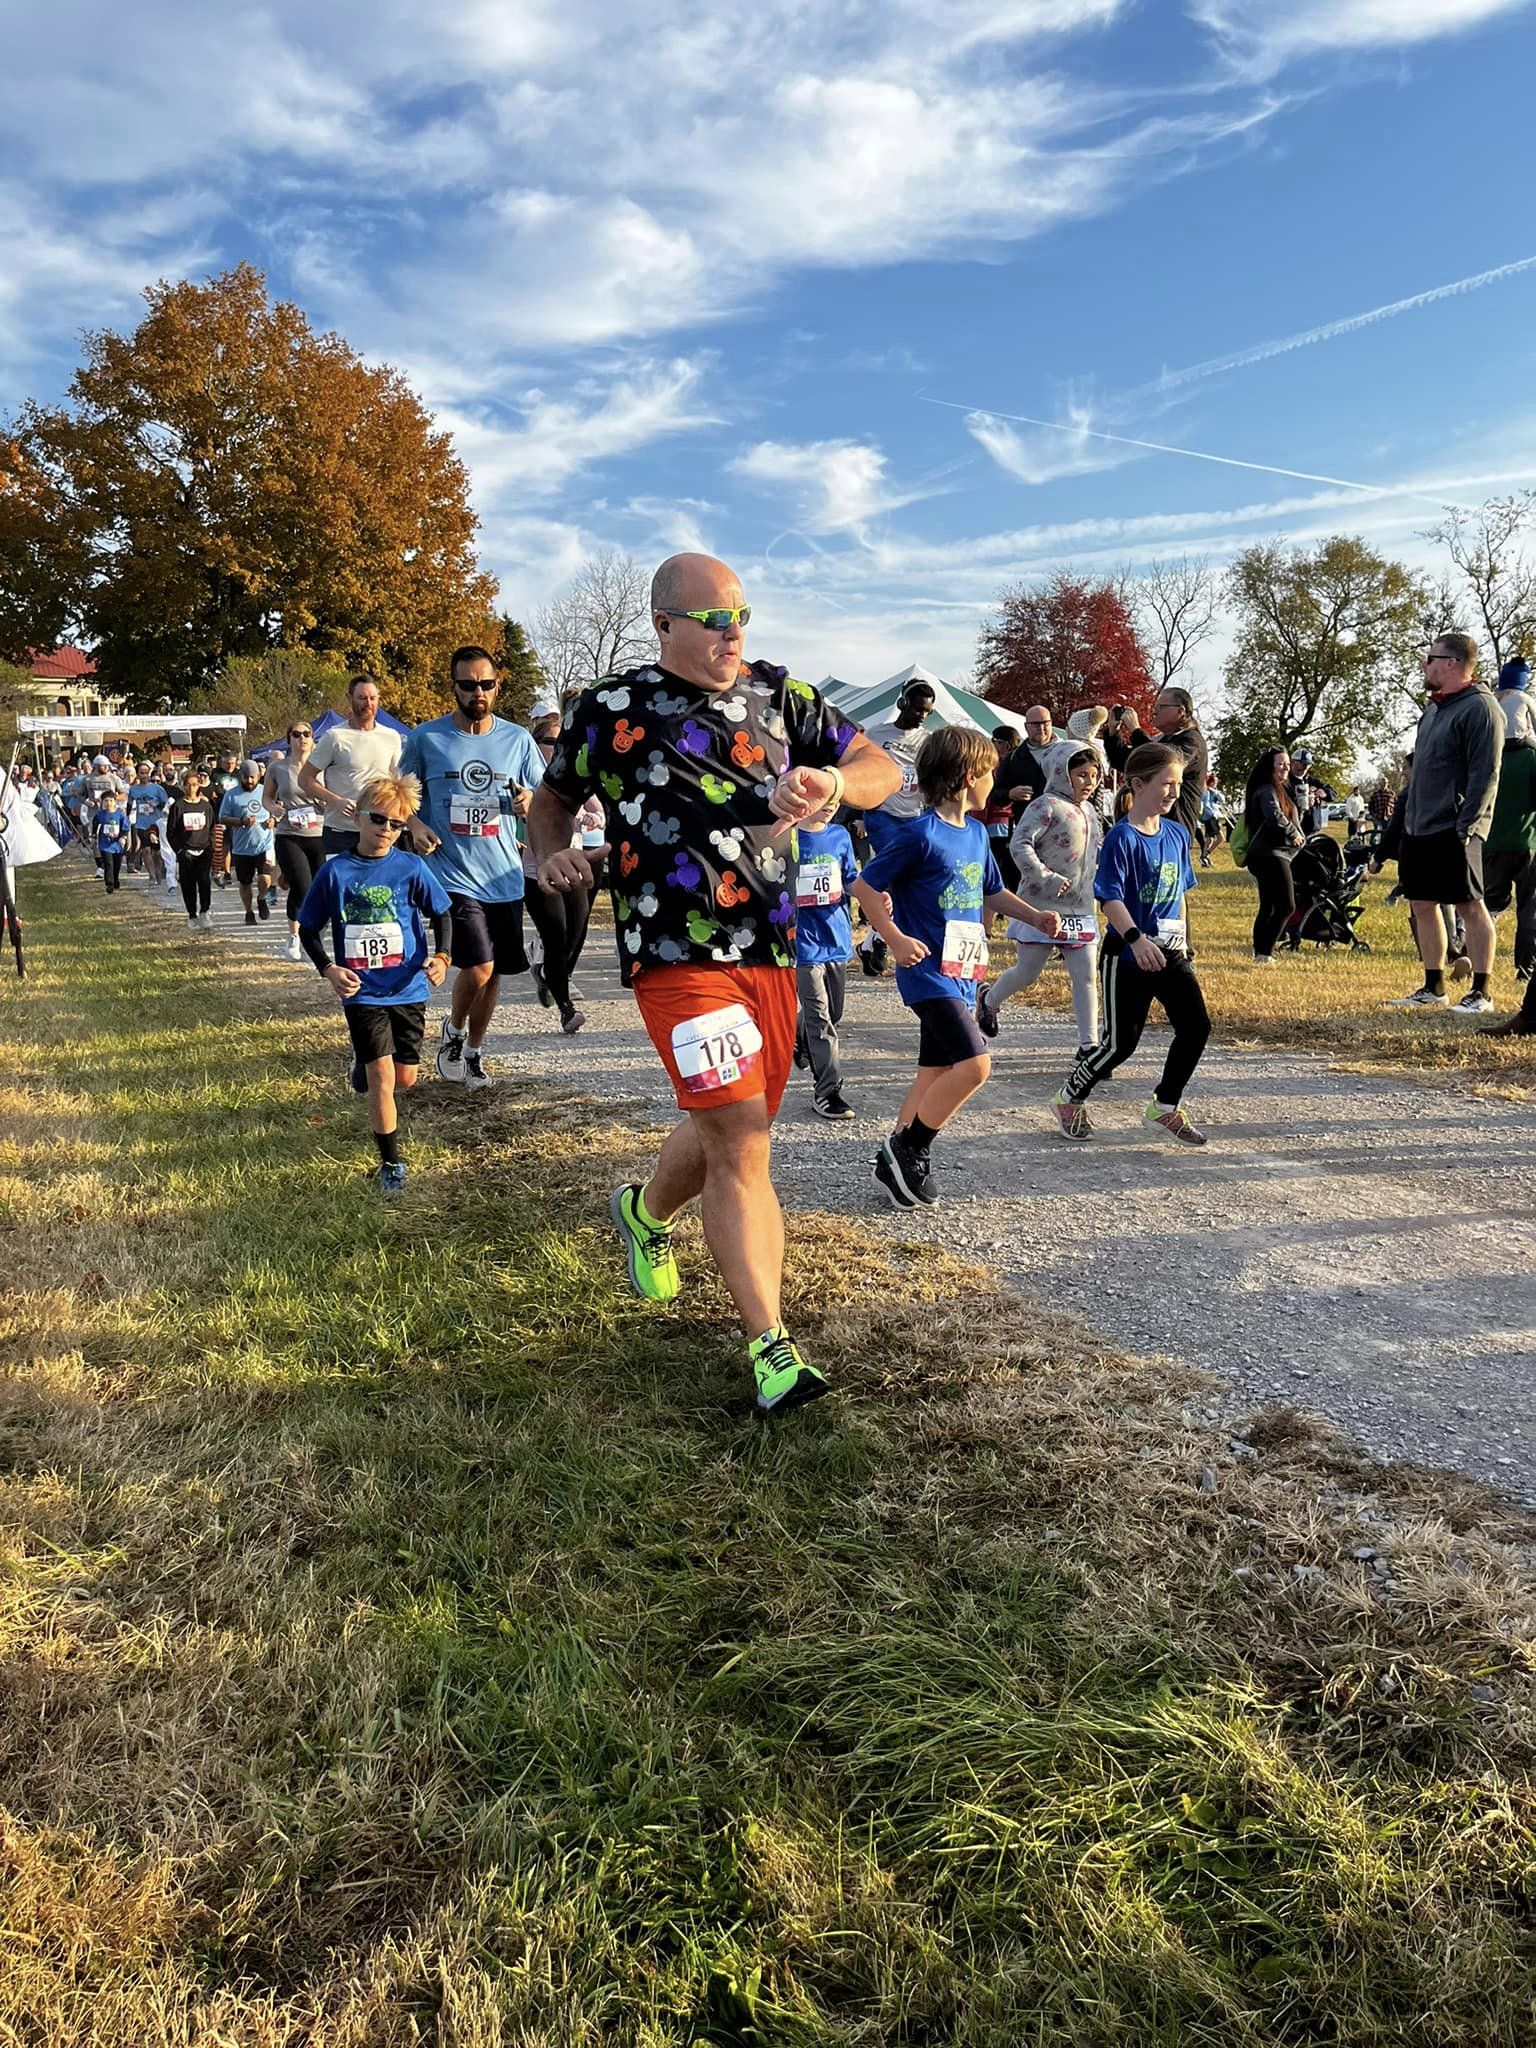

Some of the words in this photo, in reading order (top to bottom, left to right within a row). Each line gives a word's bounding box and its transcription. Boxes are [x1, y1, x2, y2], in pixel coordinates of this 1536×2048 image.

[464, 808, 489, 824] 182
[813, 876, 830, 893] 46
[1061, 918, 1083, 932] 295
[360, 938, 388, 956] 183
[958, 940, 982, 963] 374
[699, 1031, 743, 1067] 178
